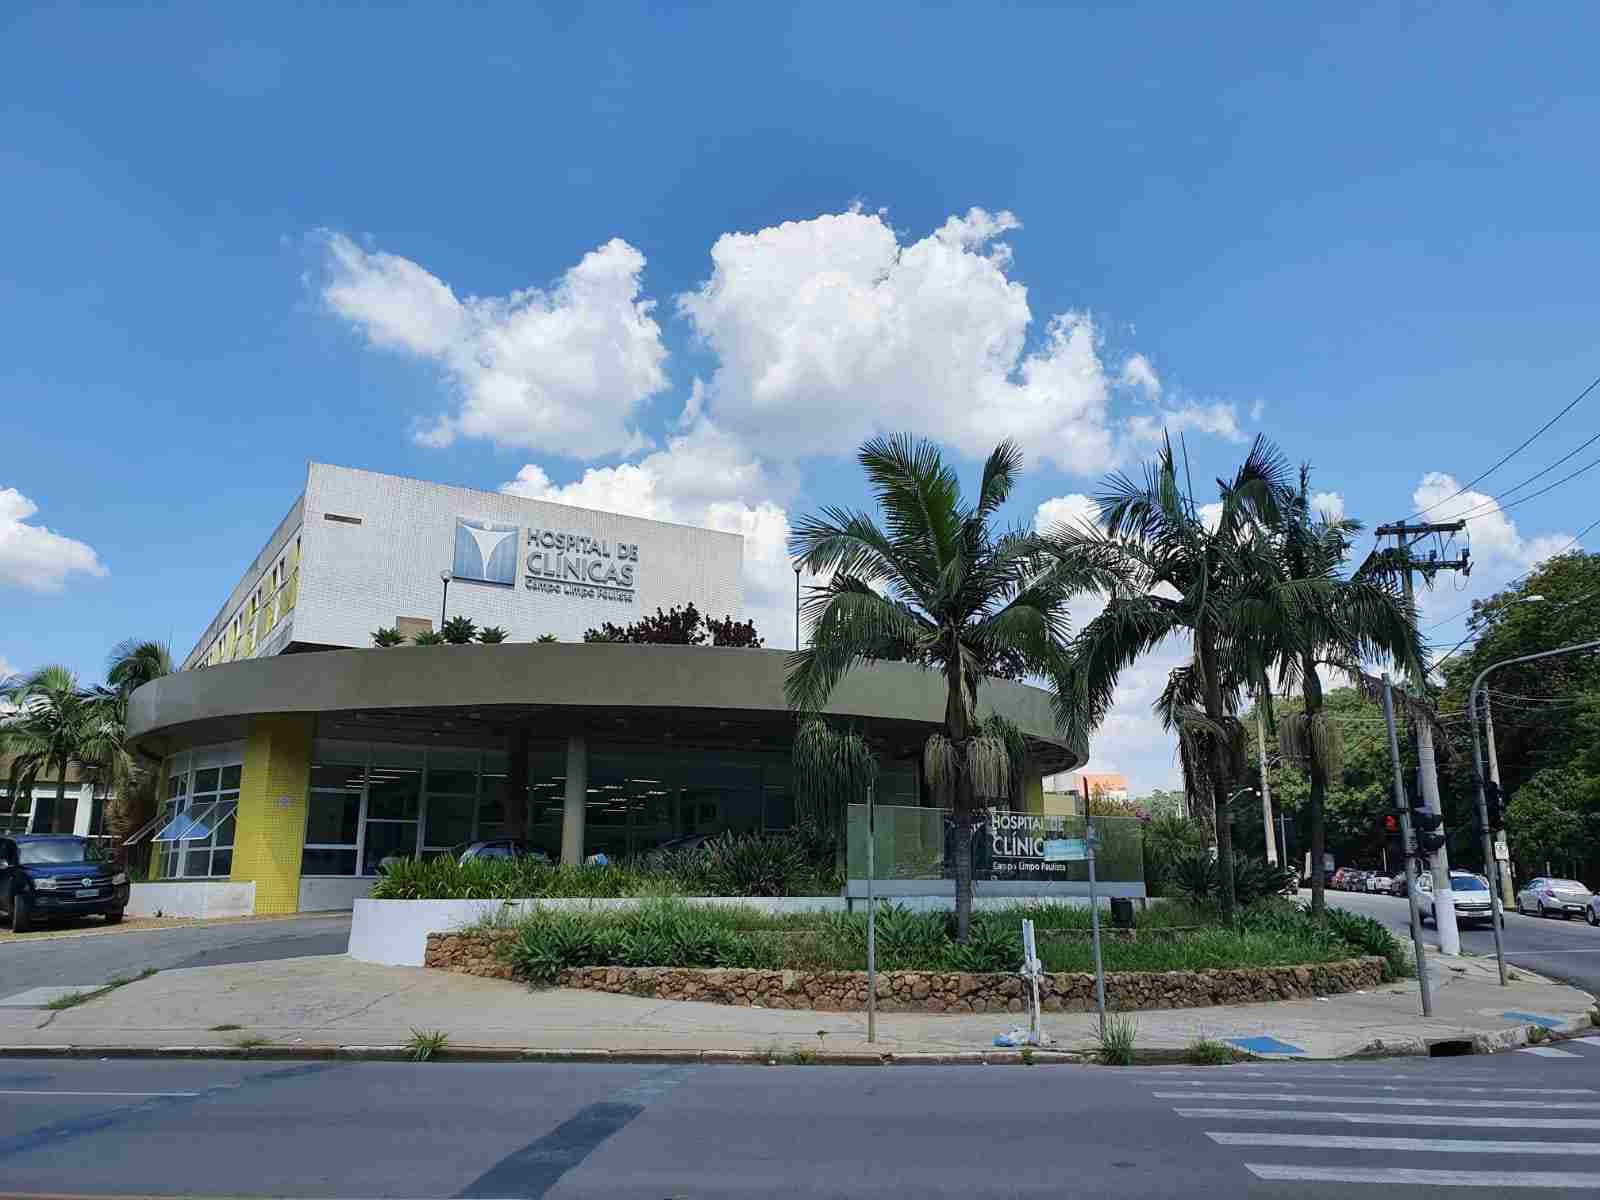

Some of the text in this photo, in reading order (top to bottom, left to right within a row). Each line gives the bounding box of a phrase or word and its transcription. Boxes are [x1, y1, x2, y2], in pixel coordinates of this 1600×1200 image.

[527, 528, 638, 562] HOSPITAL DE
[526, 552, 634, 587] CLÍNICAS
[525, 577, 561, 595] Campo
[564, 584, 595, 600] Limpo
[992, 815, 1065, 832] HOSPITAL DE
[992, 831, 1045, 857] CLÍNIC
[1018, 862, 1040, 872] Limpo
[1041, 862, 1066, 872] Paulista
